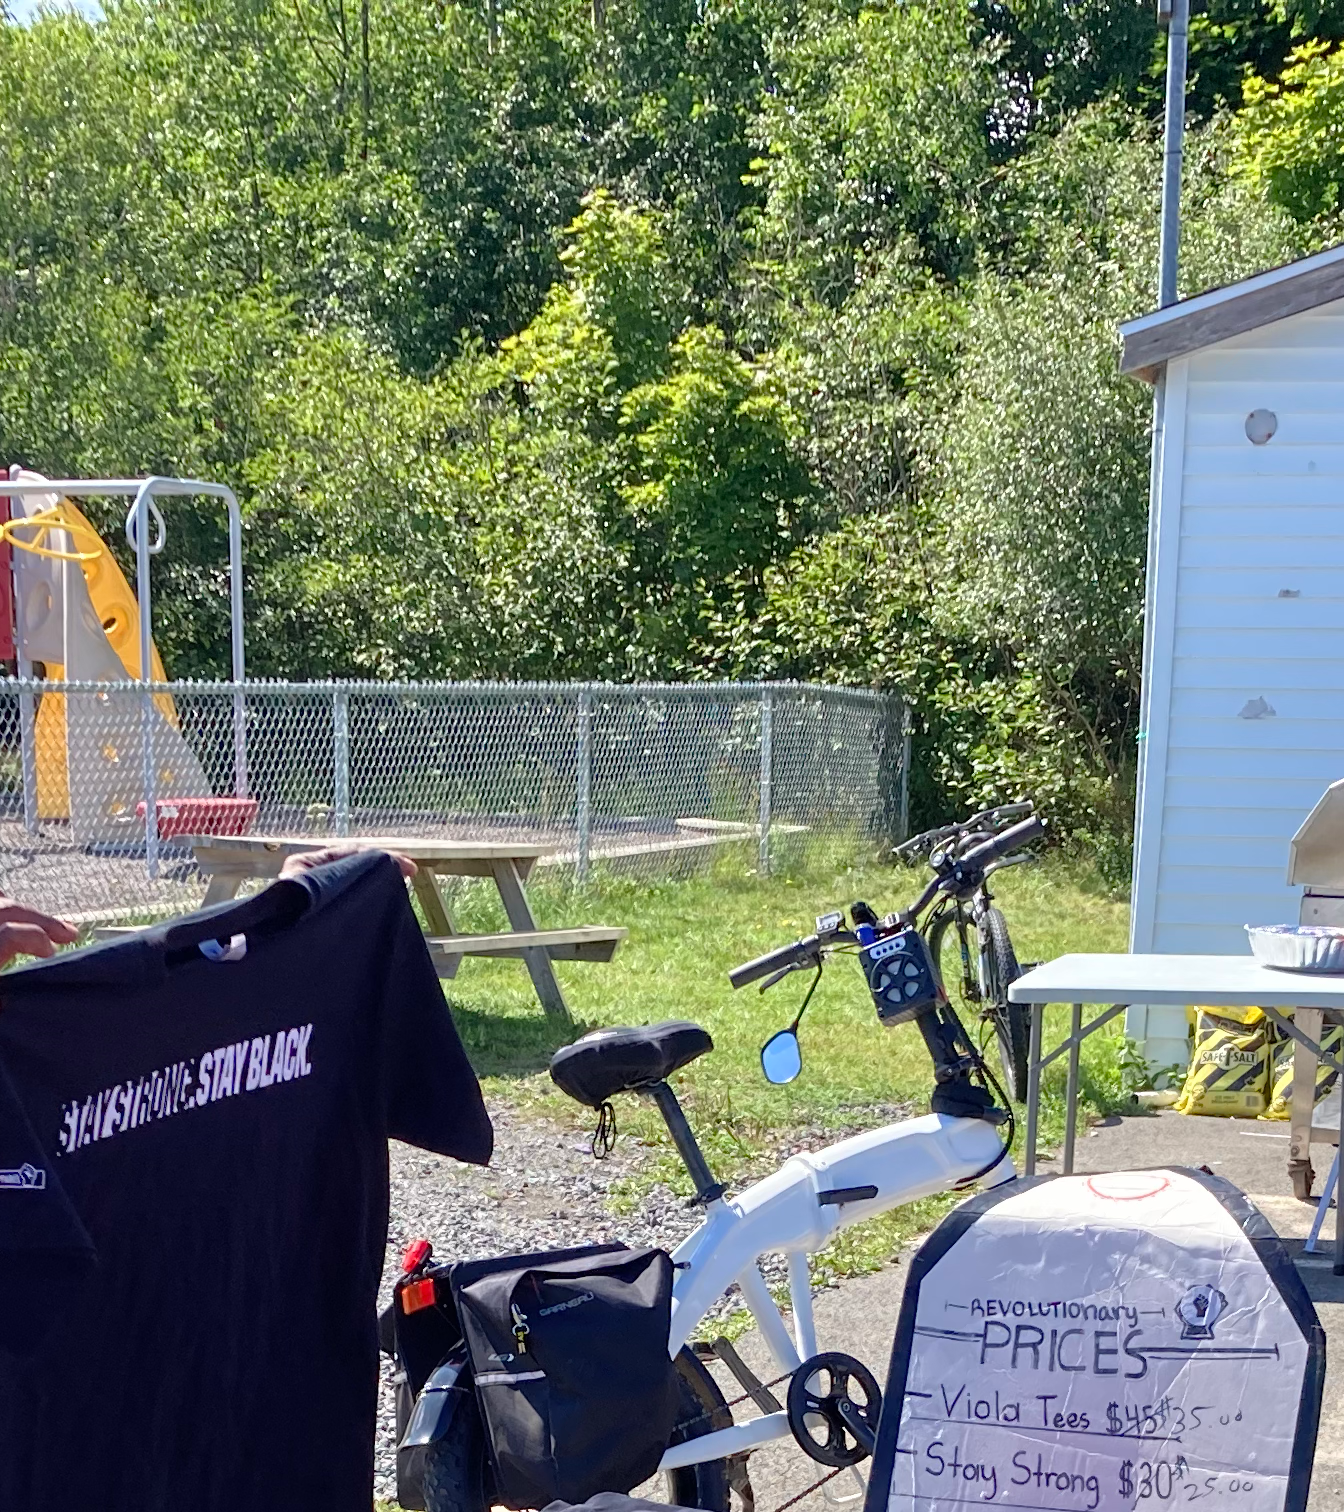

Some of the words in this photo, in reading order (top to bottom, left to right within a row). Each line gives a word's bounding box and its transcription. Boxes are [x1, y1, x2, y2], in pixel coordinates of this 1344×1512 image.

[196, 1041, 249, 1107] STAY
[245, 1023, 313, 1091] BLACK.
[979, 1320, 1148, 1379] PRICES
[940, 1384, 1020, 1423] Viola
[1036, 1395, 1091, 1430] Tees
[925, 1442, 997, 1500] Stay
[1011, 1451, 1100, 1509] Strong
